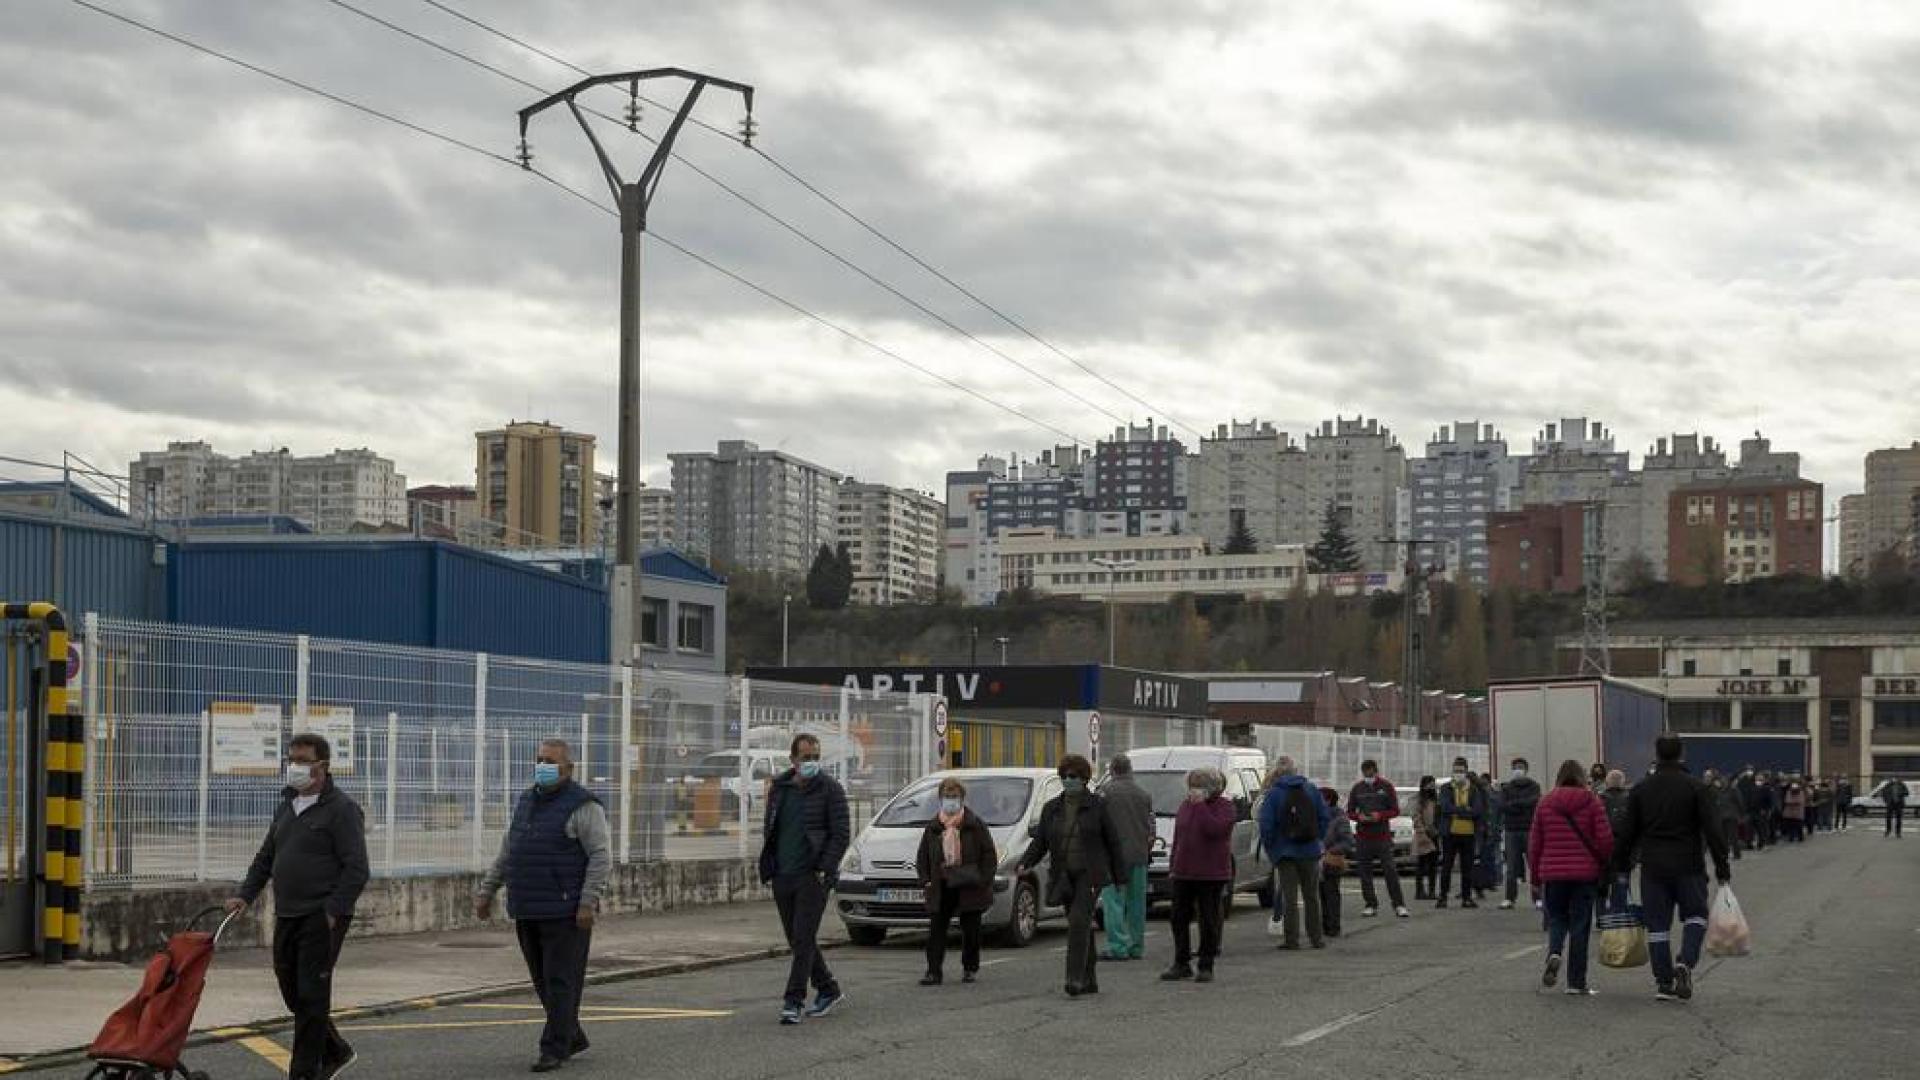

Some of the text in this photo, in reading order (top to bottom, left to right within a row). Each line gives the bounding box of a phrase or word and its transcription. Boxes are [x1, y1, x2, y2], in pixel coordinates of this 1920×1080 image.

[841, 674, 980, 701] APTIV
[1133, 677, 1180, 708] APTIV
[1716, 679, 1772, 695] JOSE
